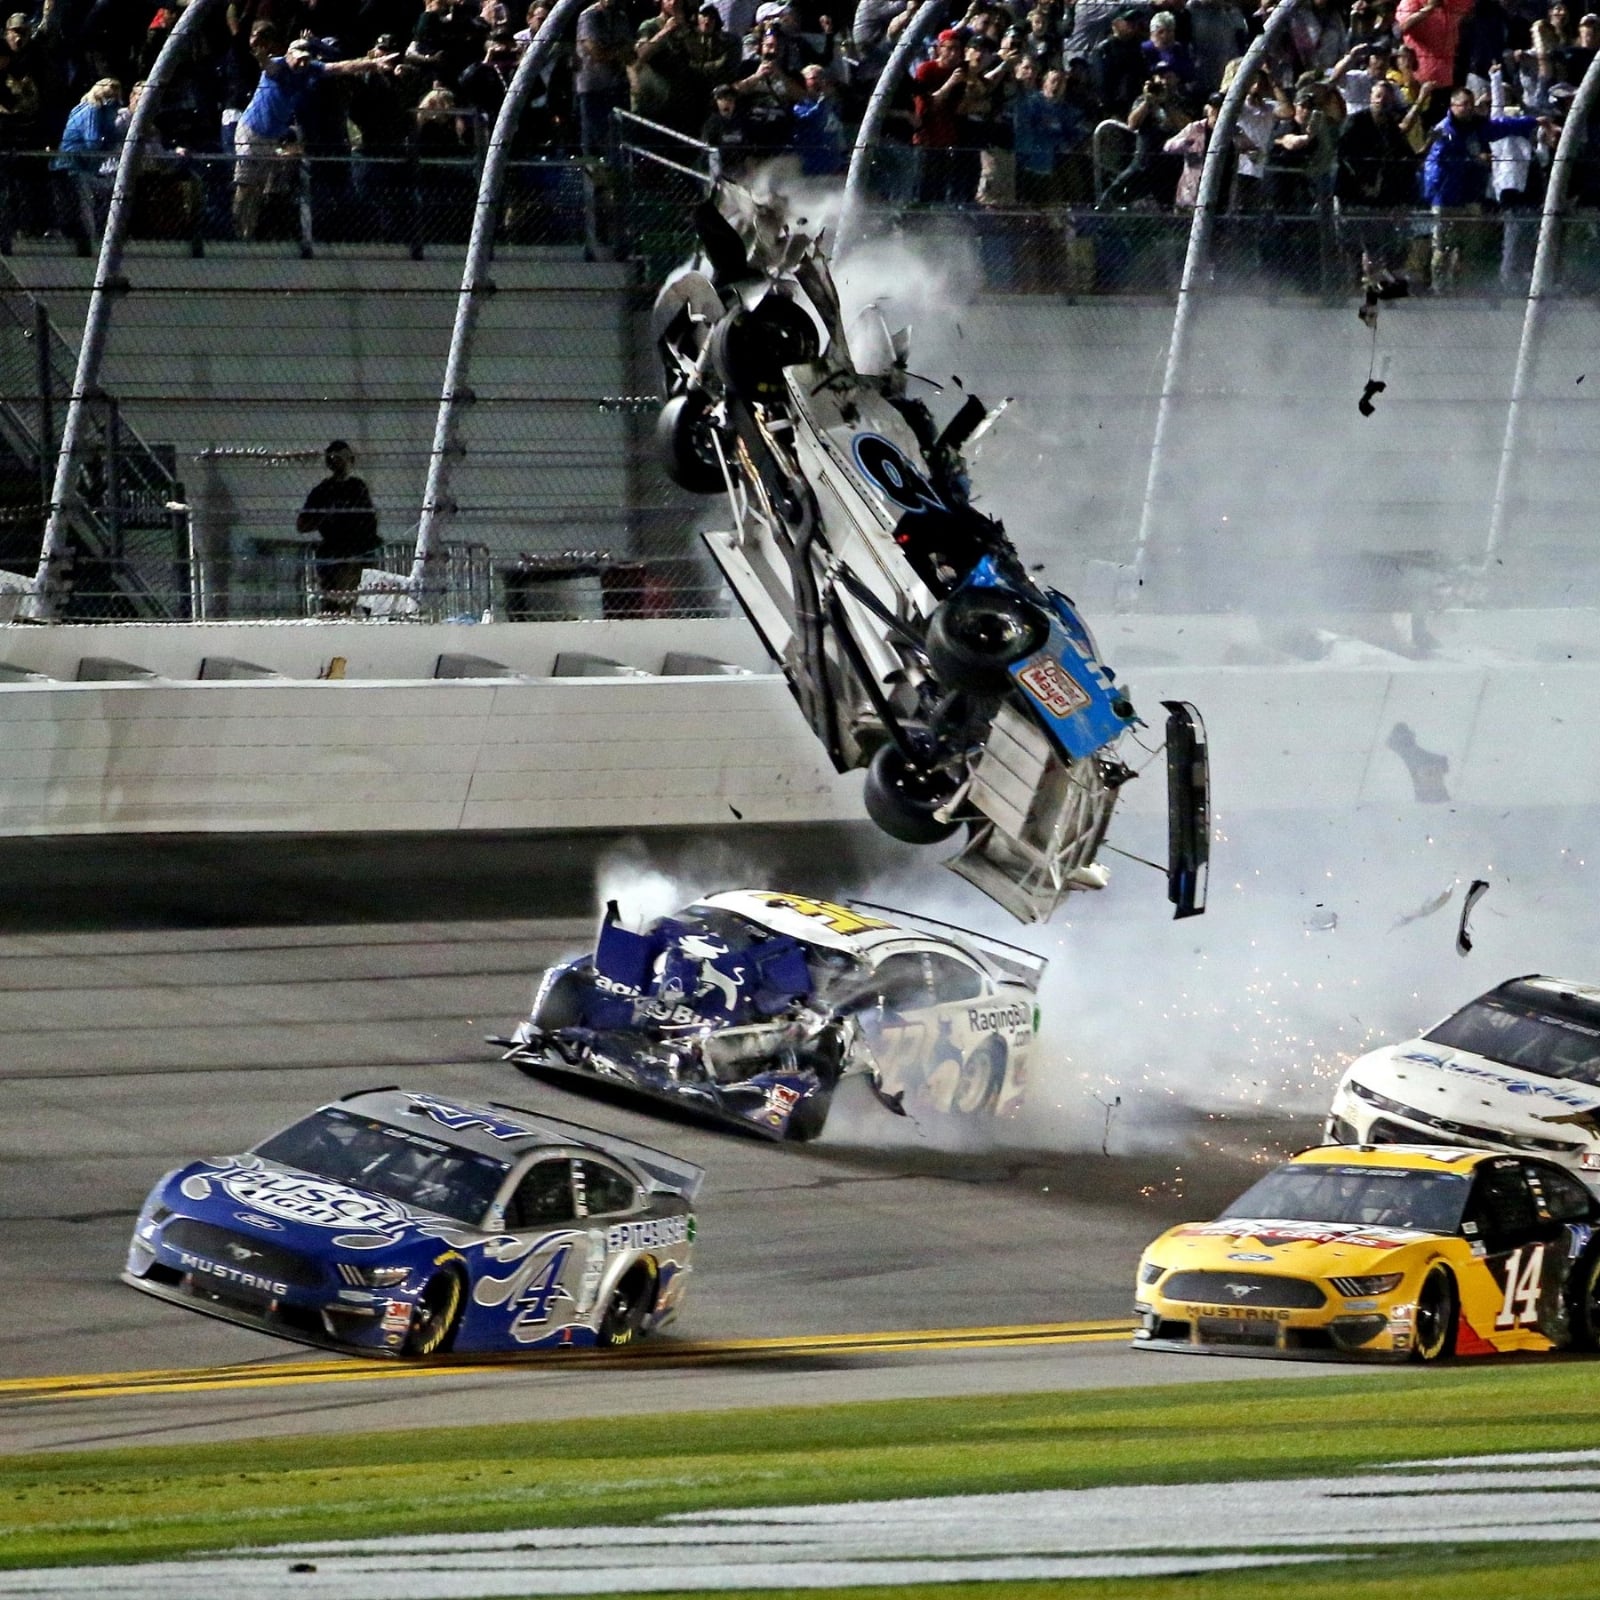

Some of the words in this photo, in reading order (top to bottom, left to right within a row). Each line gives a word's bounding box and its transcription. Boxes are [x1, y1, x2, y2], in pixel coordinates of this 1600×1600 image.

[1032, 670, 1070, 706] Mayer
[219, 1169, 415, 1236] BUSCH
[180, 1252, 288, 1296] MUSTANG
[516, 1242, 573, 1325] 4
[1495, 1245, 1545, 1329] 14
[1186, 1305, 1290, 1320] MUSTANG
